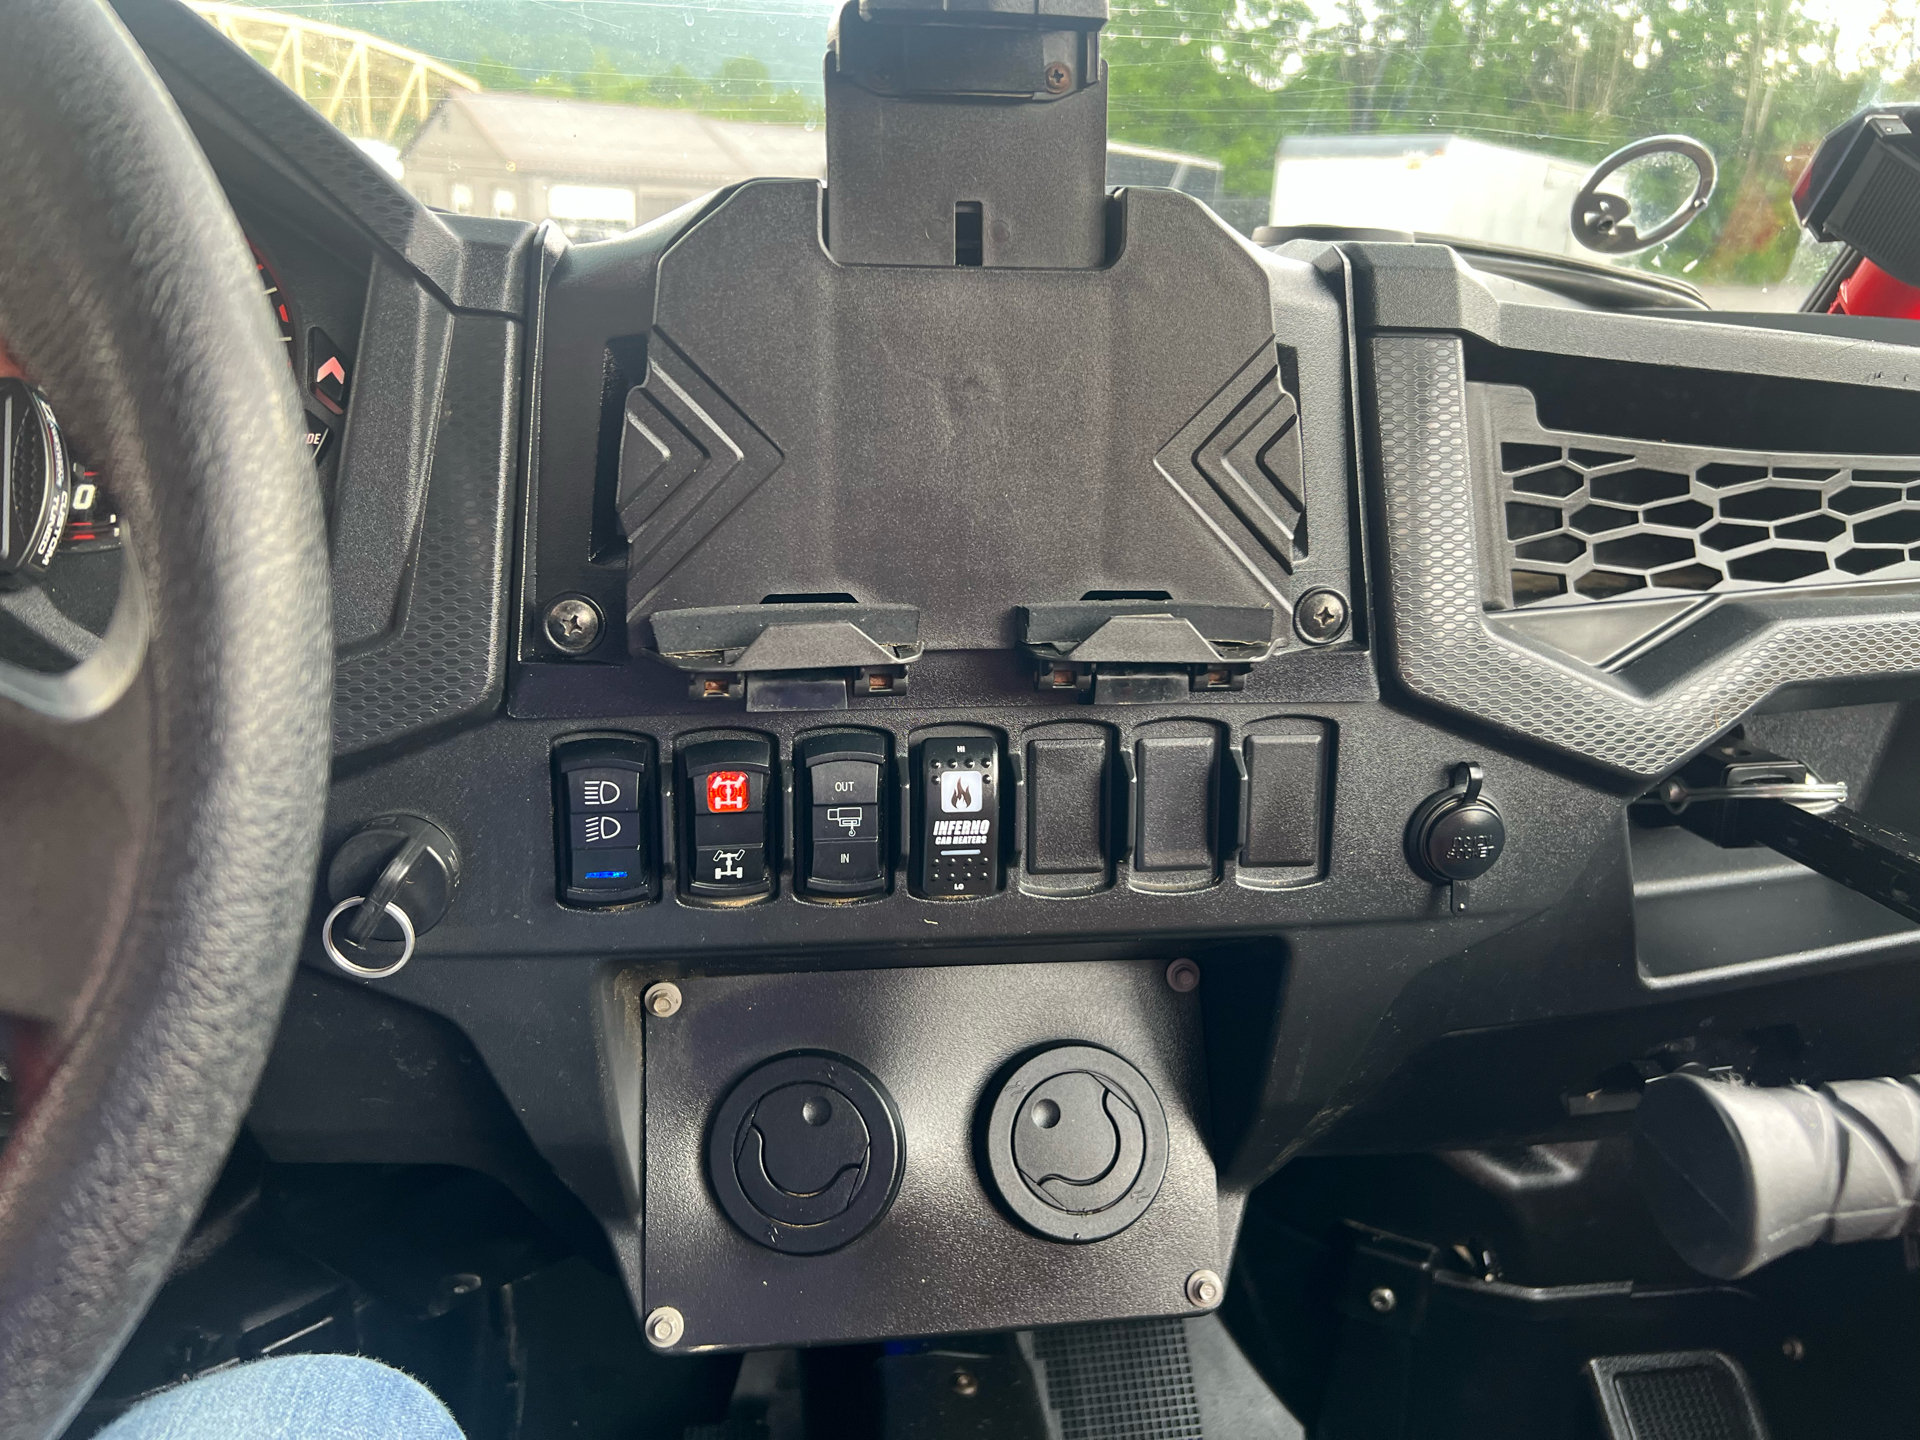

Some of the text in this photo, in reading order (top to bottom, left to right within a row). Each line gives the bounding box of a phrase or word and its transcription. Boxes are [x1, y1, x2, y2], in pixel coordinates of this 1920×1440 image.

[37, 494, 60, 555] TUNED
[41, 490, 68, 566] CUSTOM
[956, 745, 966, 753] HI
[834, 781, 855, 792] OUT
[932, 819, 990, 836] INFERNO
[934, 835, 988, 845] CAB HEATERS
[840, 853, 850, 864] IN
[953, 883, 965, 891] LO
